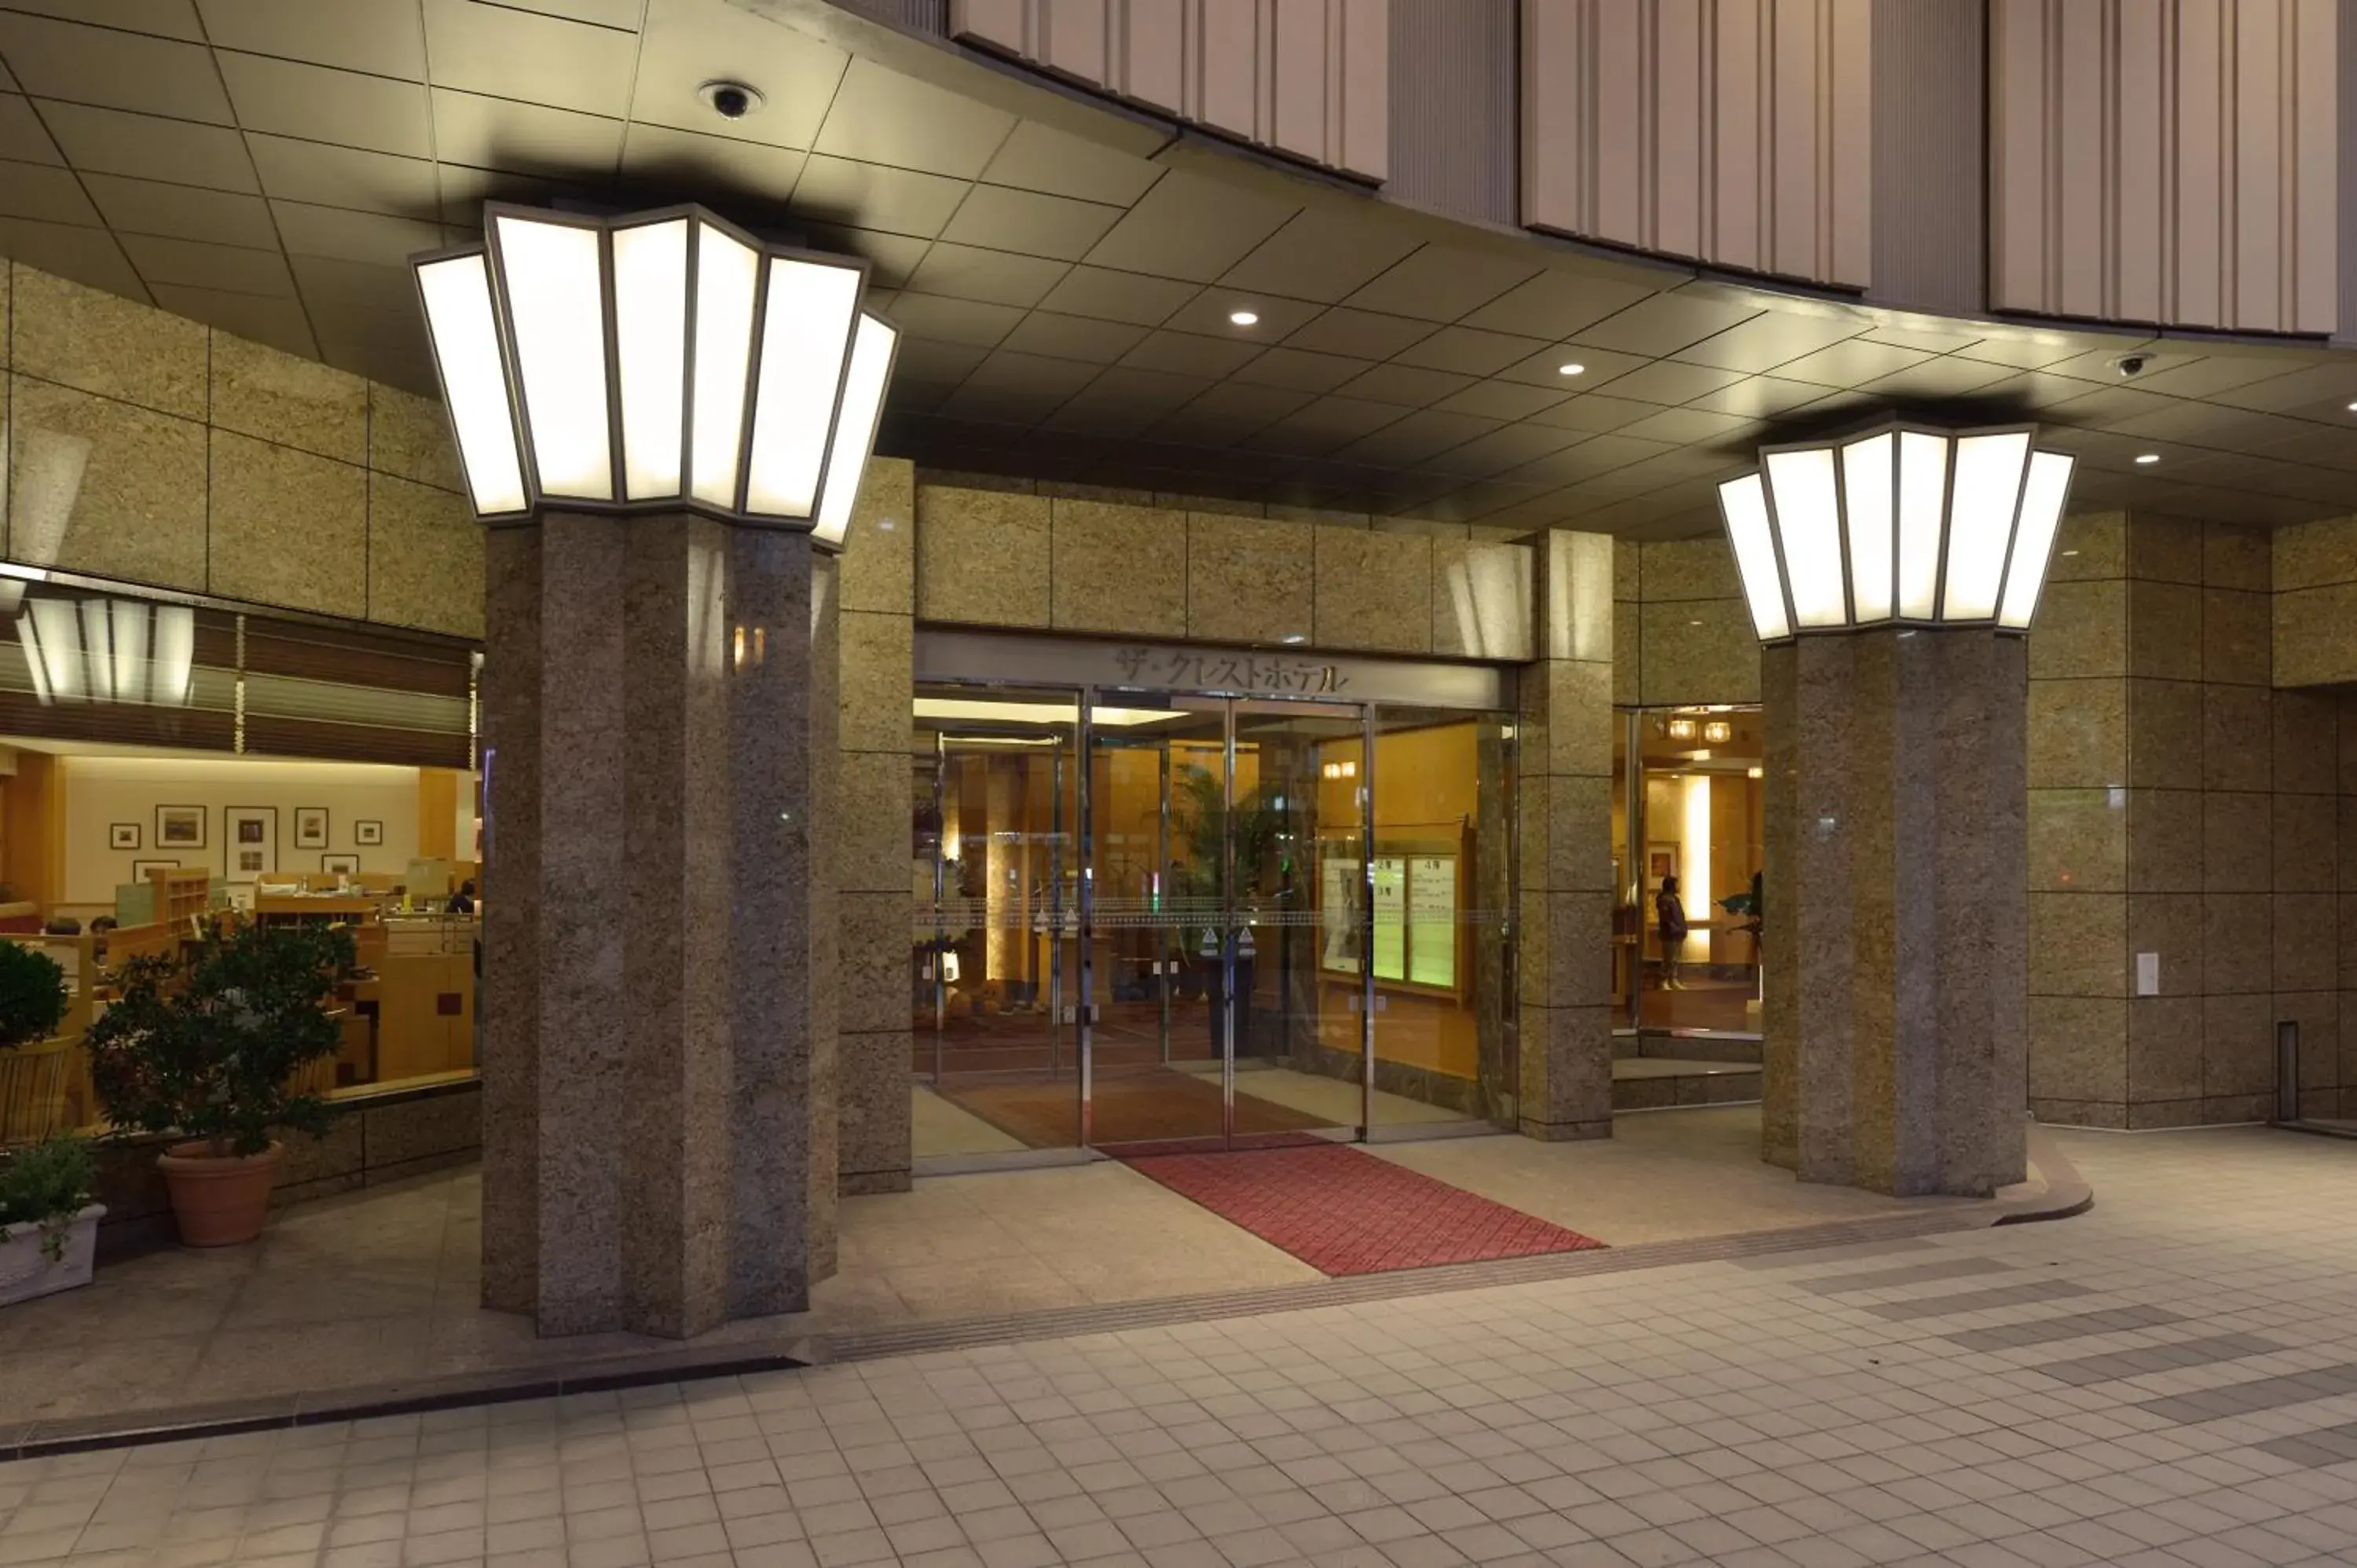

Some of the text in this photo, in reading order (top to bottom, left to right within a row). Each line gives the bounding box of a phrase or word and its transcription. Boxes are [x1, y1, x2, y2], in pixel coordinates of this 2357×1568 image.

[1115, 647, 1349, 693] ザ・クレストホテル
